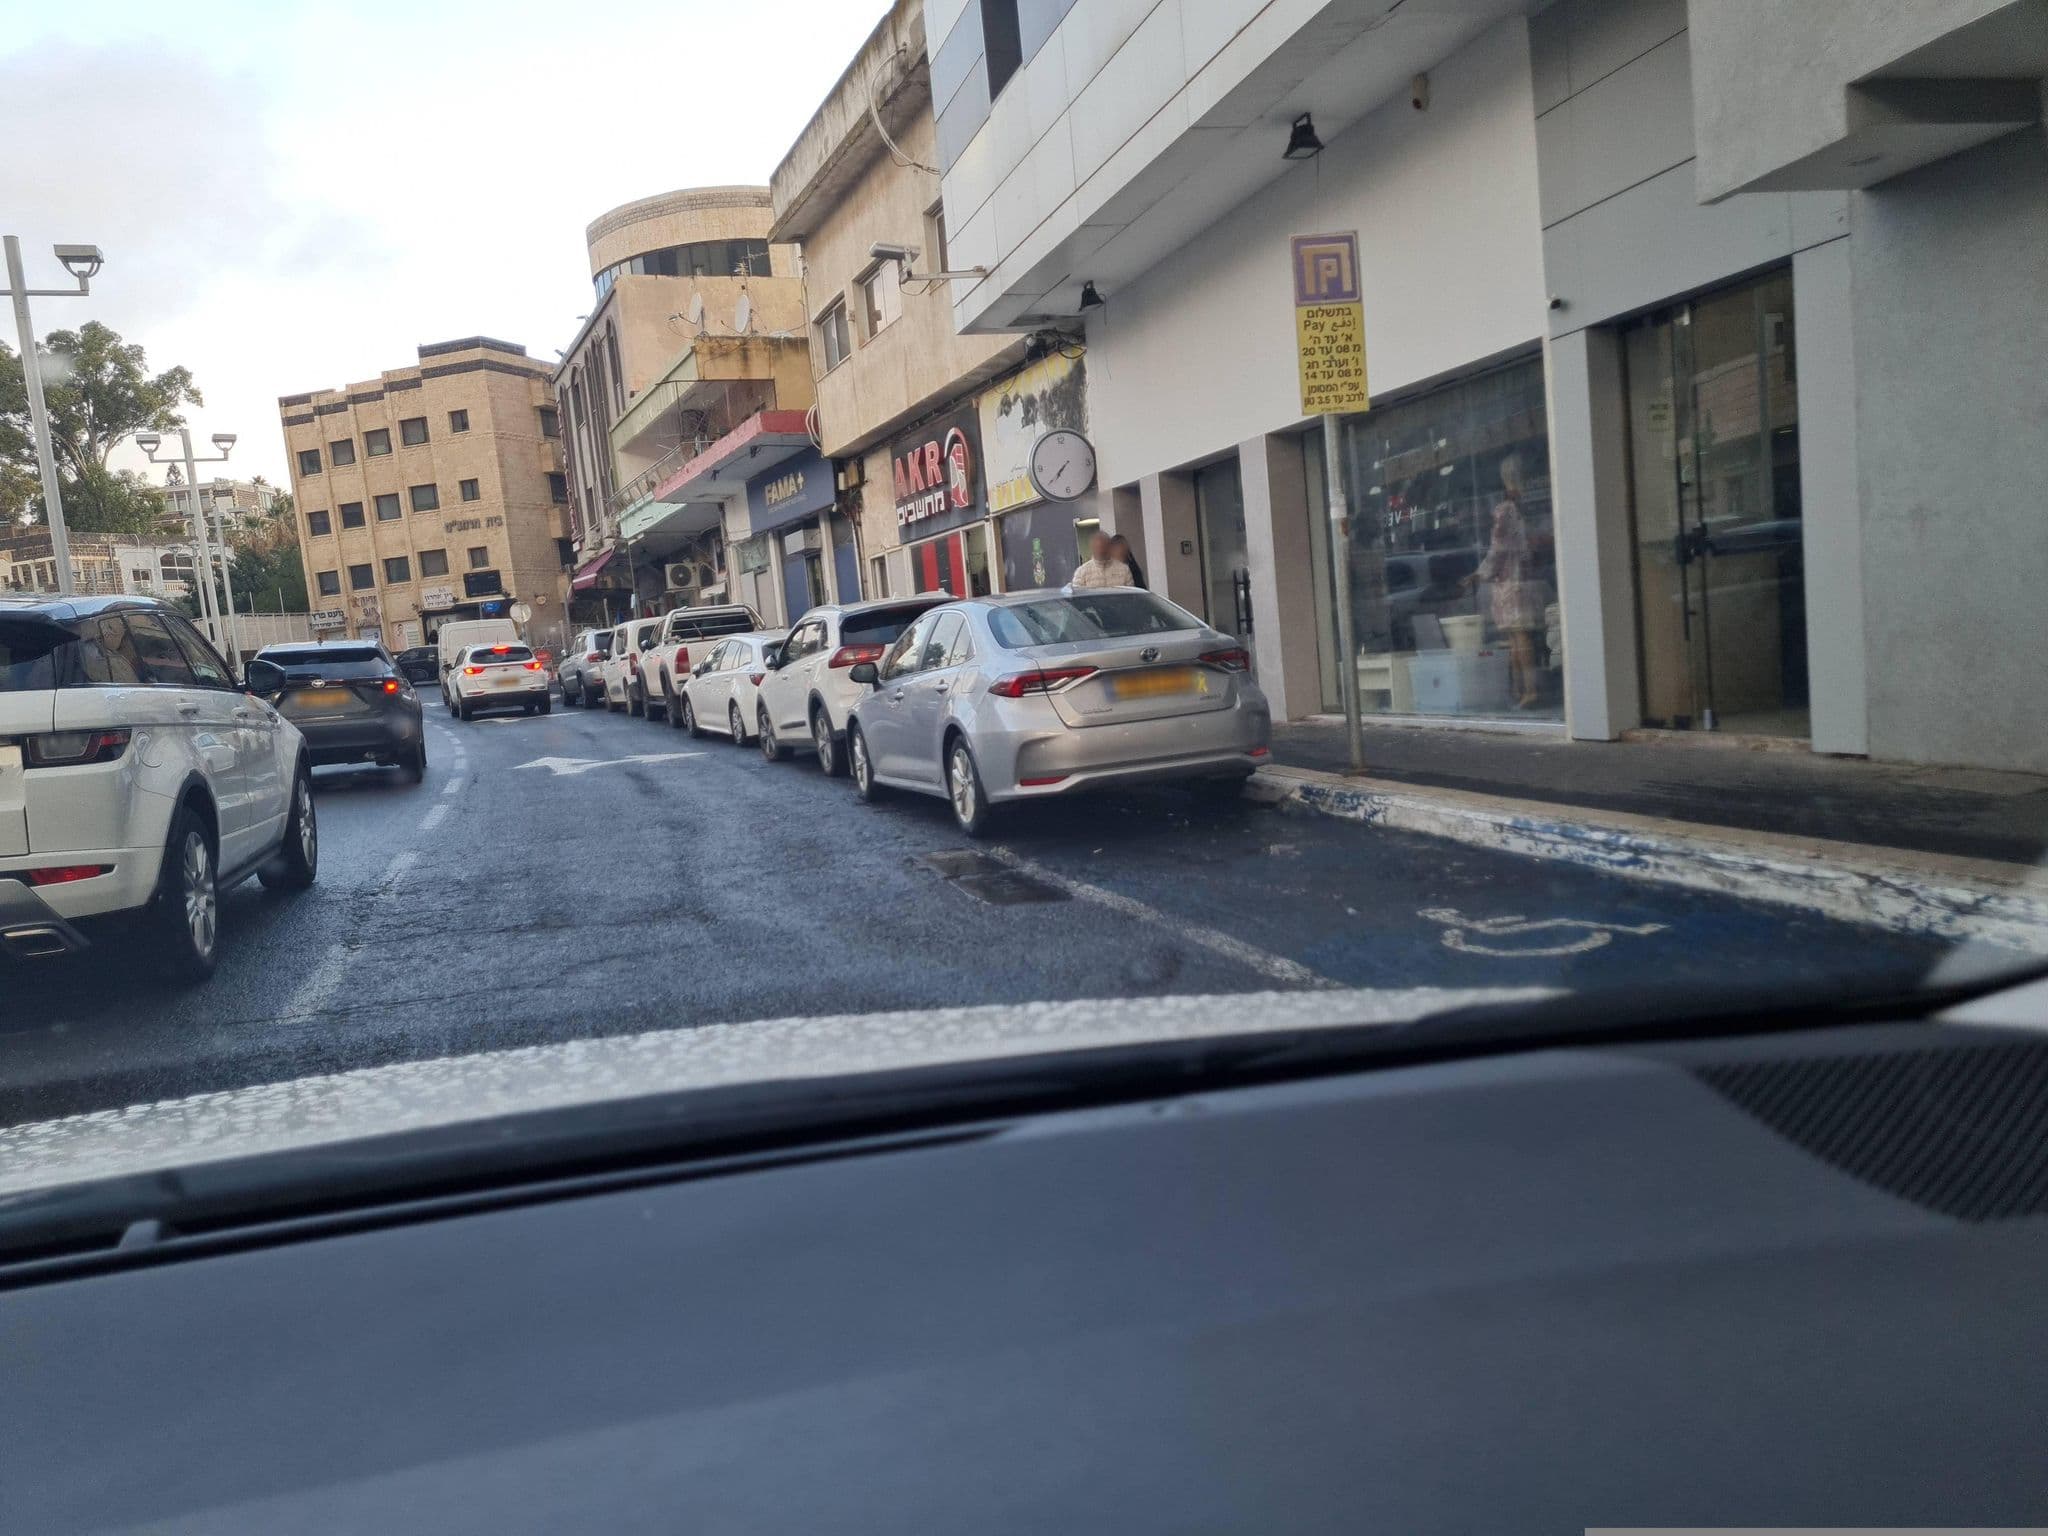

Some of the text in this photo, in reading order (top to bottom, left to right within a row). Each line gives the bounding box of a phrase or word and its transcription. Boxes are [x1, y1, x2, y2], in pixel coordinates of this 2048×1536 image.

[1307, 307, 1352, 318] בתשלום
[1304, 320, 1325, 332] Pay
[1324, 335, 1338, 344] עד
[1303, 347, 1316, 356] 20
[1318, 346, 1332, 355] עד
[1336, 344, 1350, 353] 08
[1306, 360, 1319, 369] חג
[1305, 371, 1317, 380] 14
[1320, 370, 1334, 380] עד
[1338, 369, 1351, 377] 08
[1331, 395, 1344, 404] עד
[896, 441, 943, 501] AKR
[897, 491, 945, 526] מחשבים
